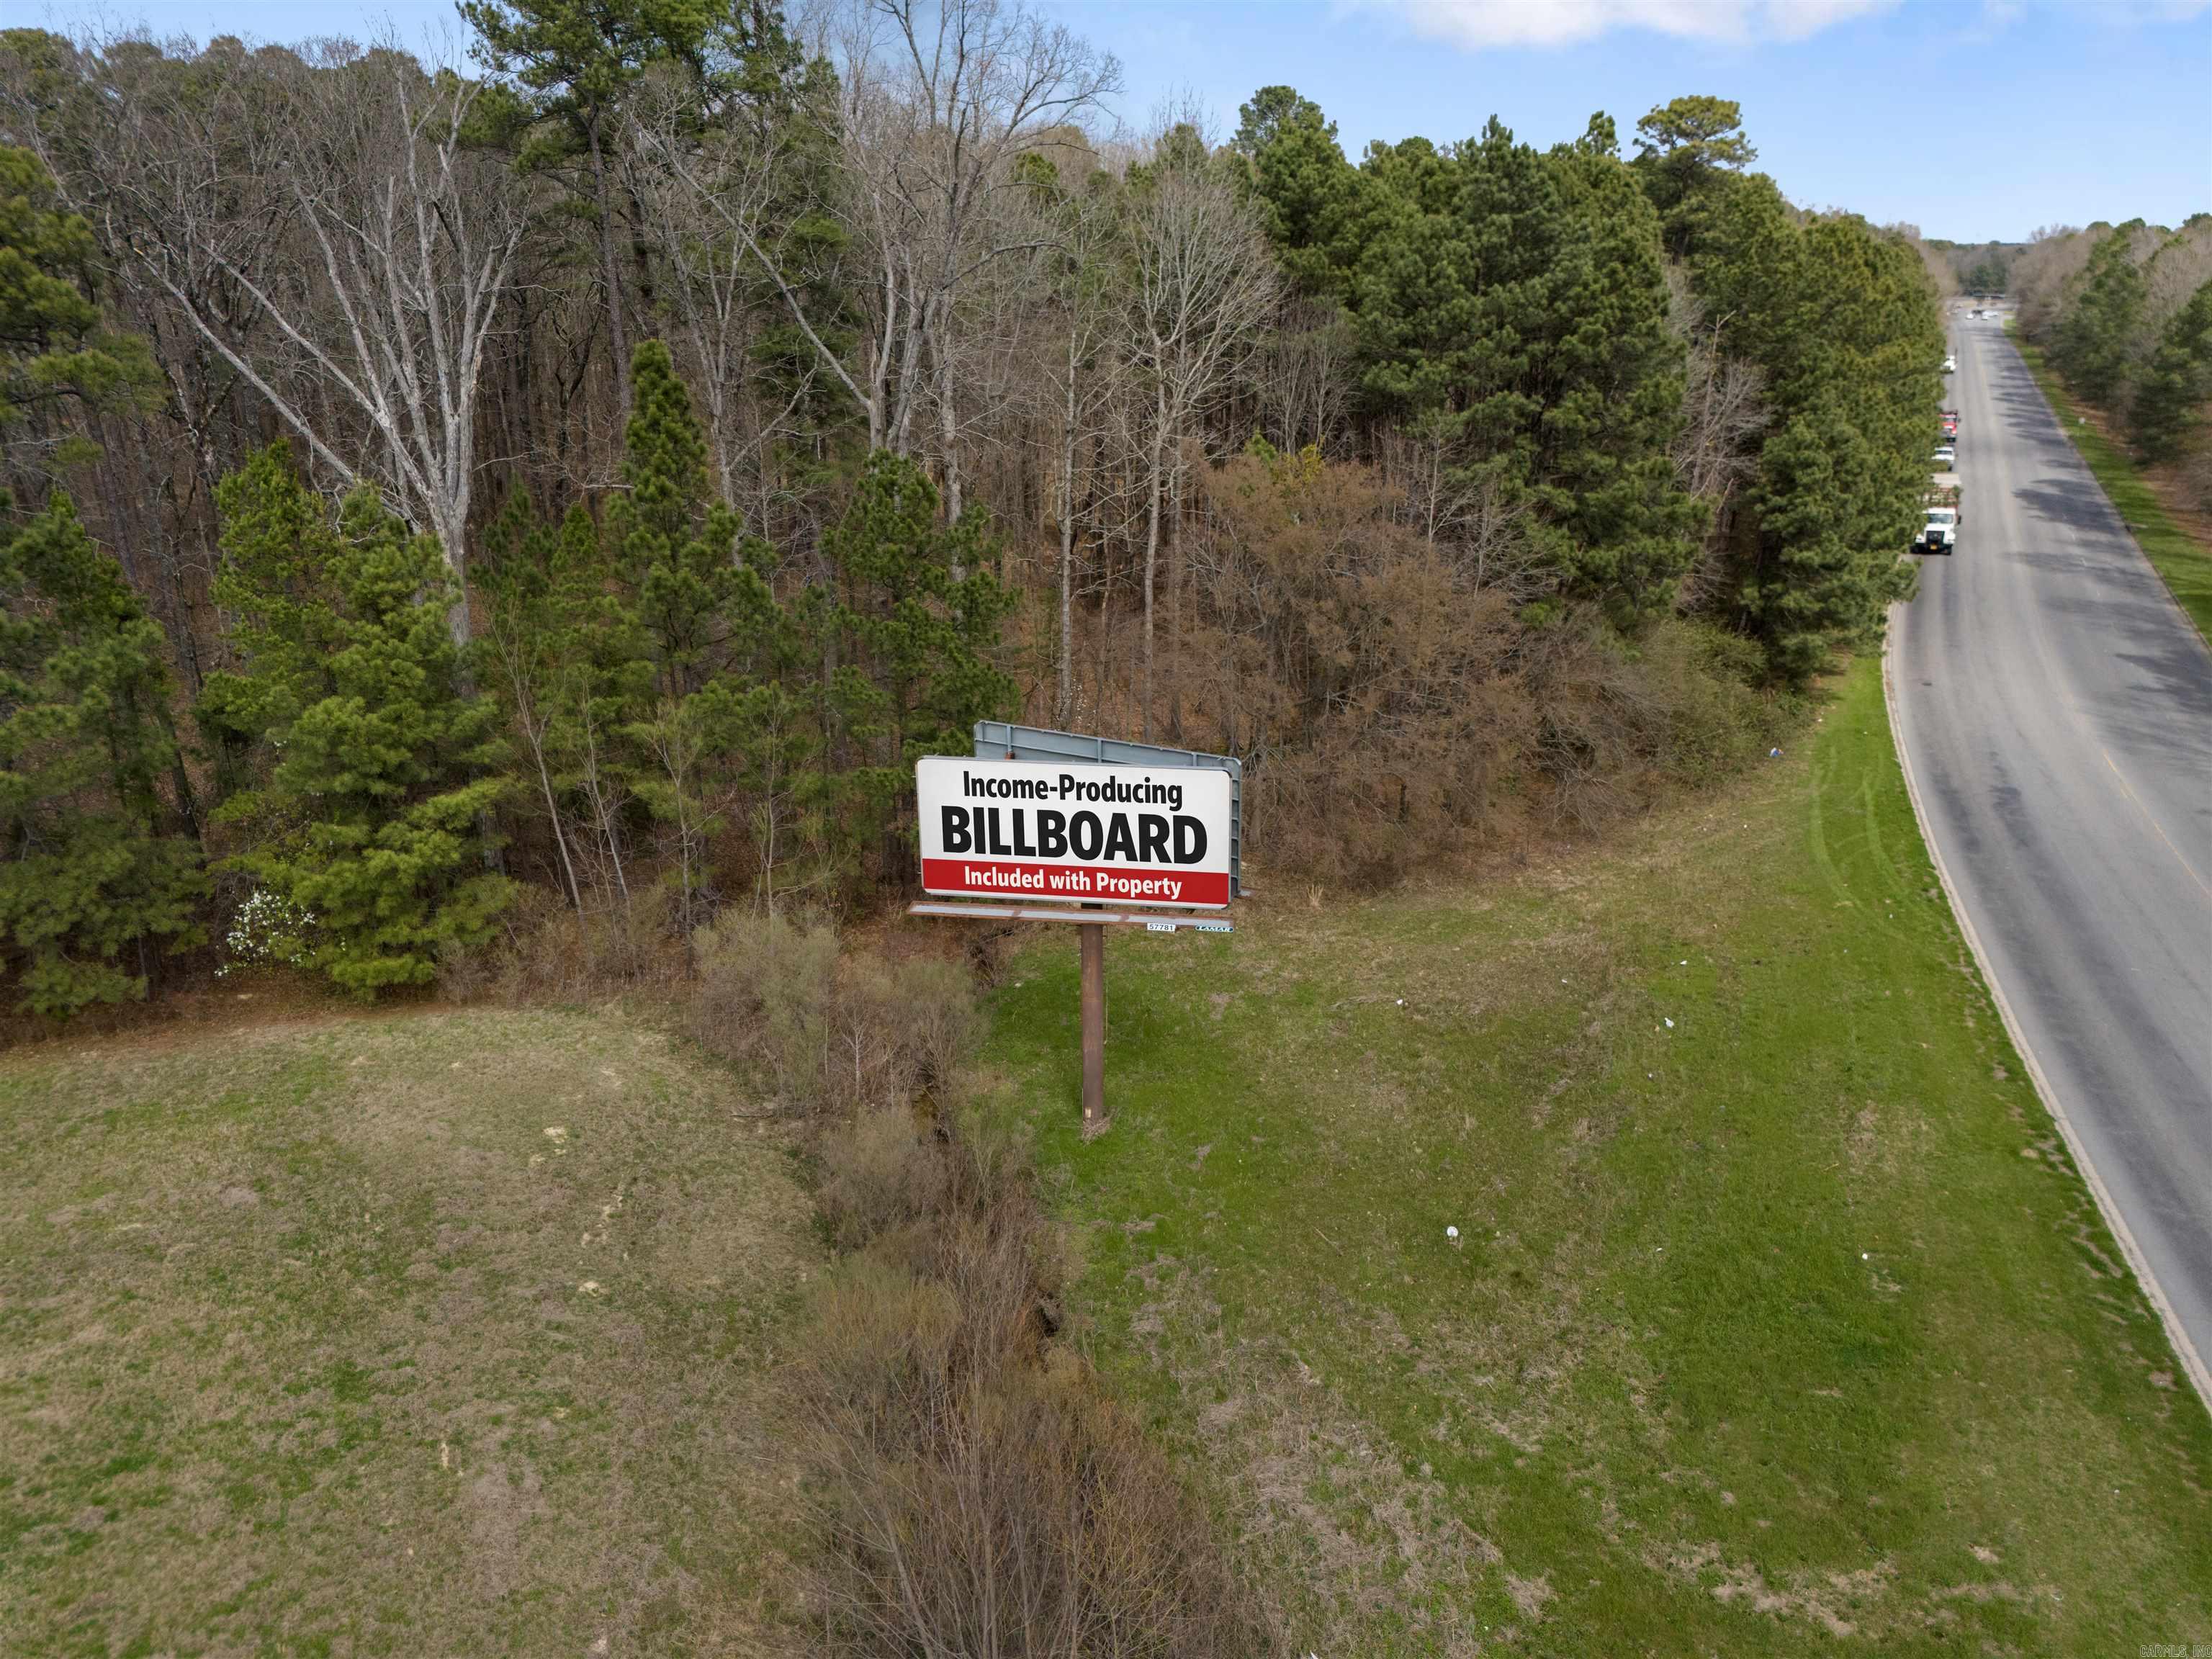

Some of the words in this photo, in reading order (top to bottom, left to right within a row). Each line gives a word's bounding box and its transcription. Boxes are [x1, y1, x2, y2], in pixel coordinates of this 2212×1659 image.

[963, 771, 1182, 811] Income-Producing
[942, 806, 1207, 864] BILLBOARD
[965, 866, 1043, 889] Included
[1049, 871, 1090, 890] with
[1097, 873, 1182, 899] Property
